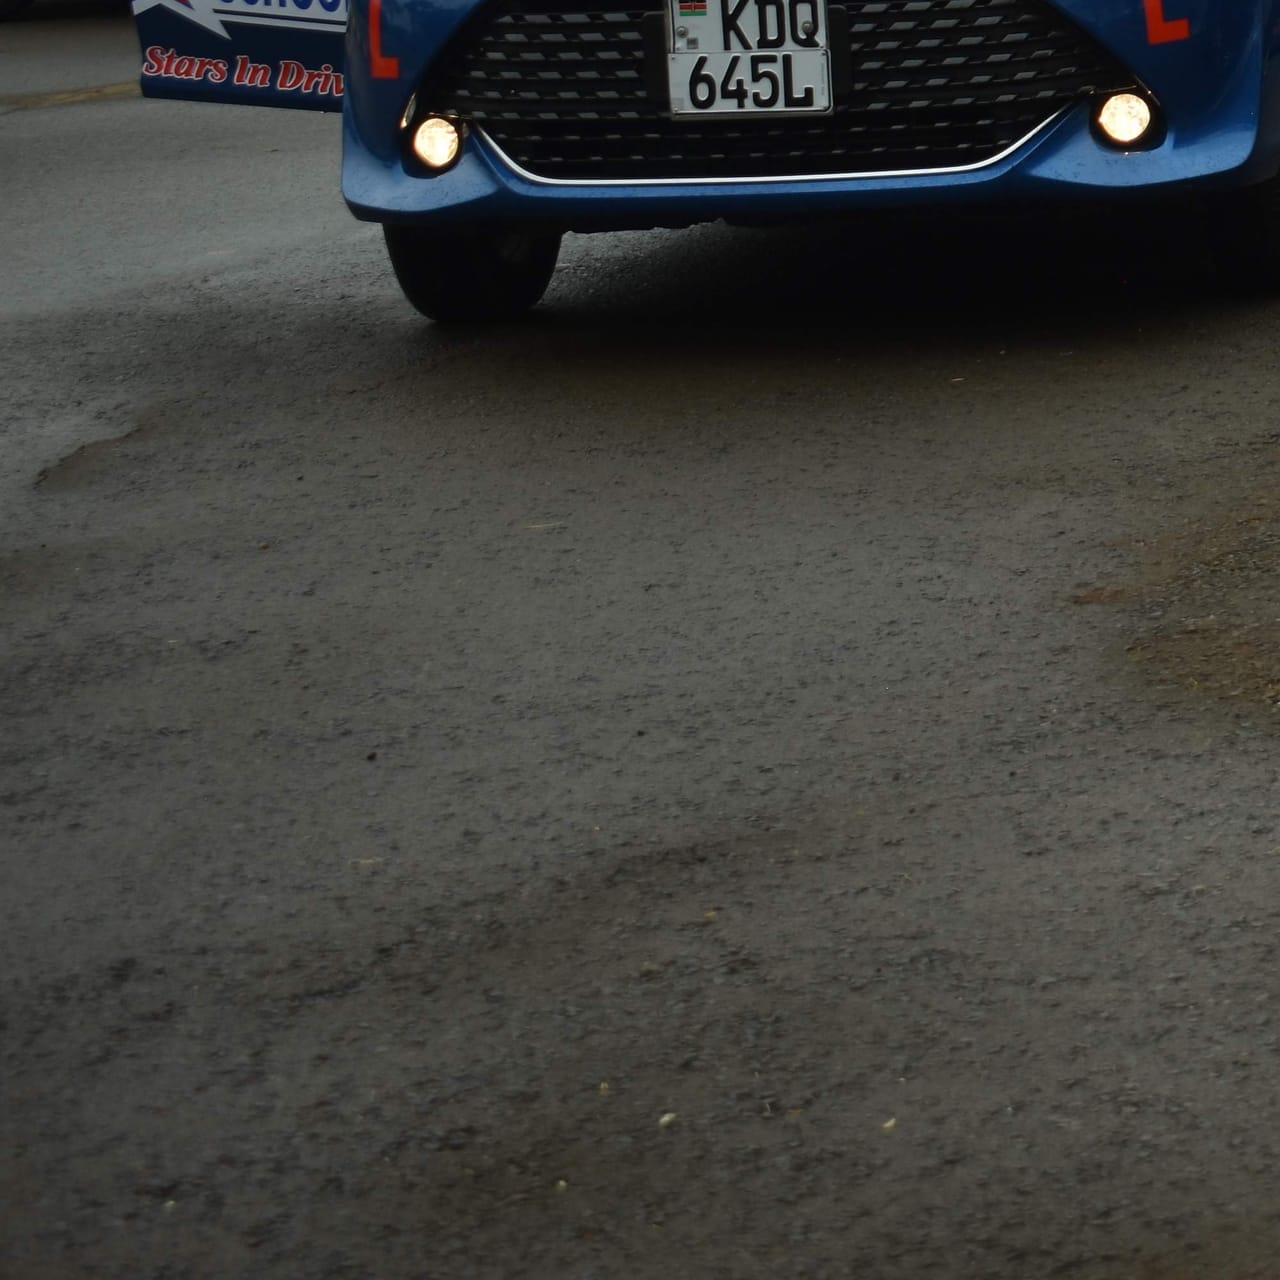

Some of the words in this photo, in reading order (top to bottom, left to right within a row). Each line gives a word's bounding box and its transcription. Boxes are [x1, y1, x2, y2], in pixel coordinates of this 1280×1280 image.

[143, 45, 228, 84] Stars
[233, 55, 270, 88] In
[689, 53, 814, 110] 645L
